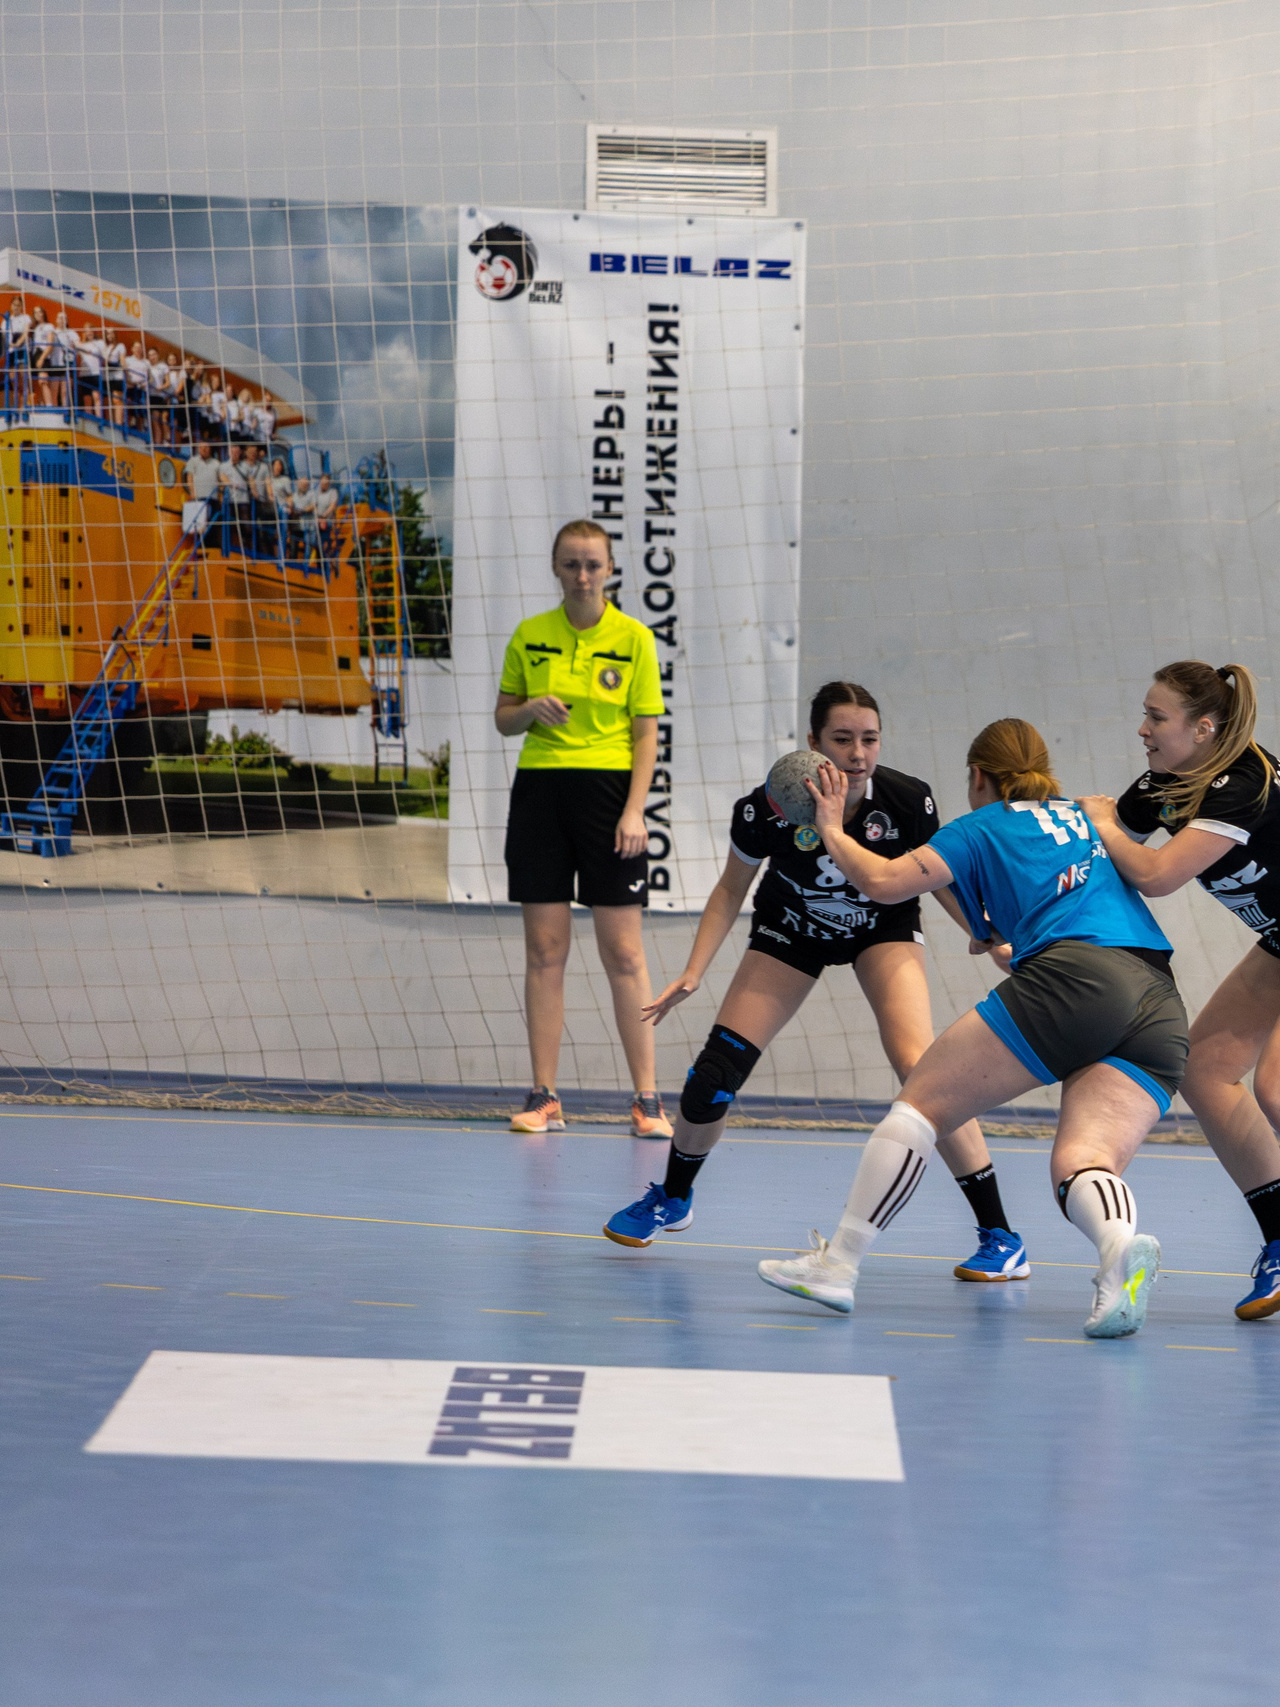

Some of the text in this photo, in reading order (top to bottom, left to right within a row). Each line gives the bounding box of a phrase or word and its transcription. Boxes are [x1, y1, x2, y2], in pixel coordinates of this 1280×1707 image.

[589, 253, 792, 279] BELAZ
[90, 285, 141, 319] 75710
[643, 303, 680, 647] ДОСТИЖЕНИЯ!
[428, 1367, 586, 1459] BELAZ
